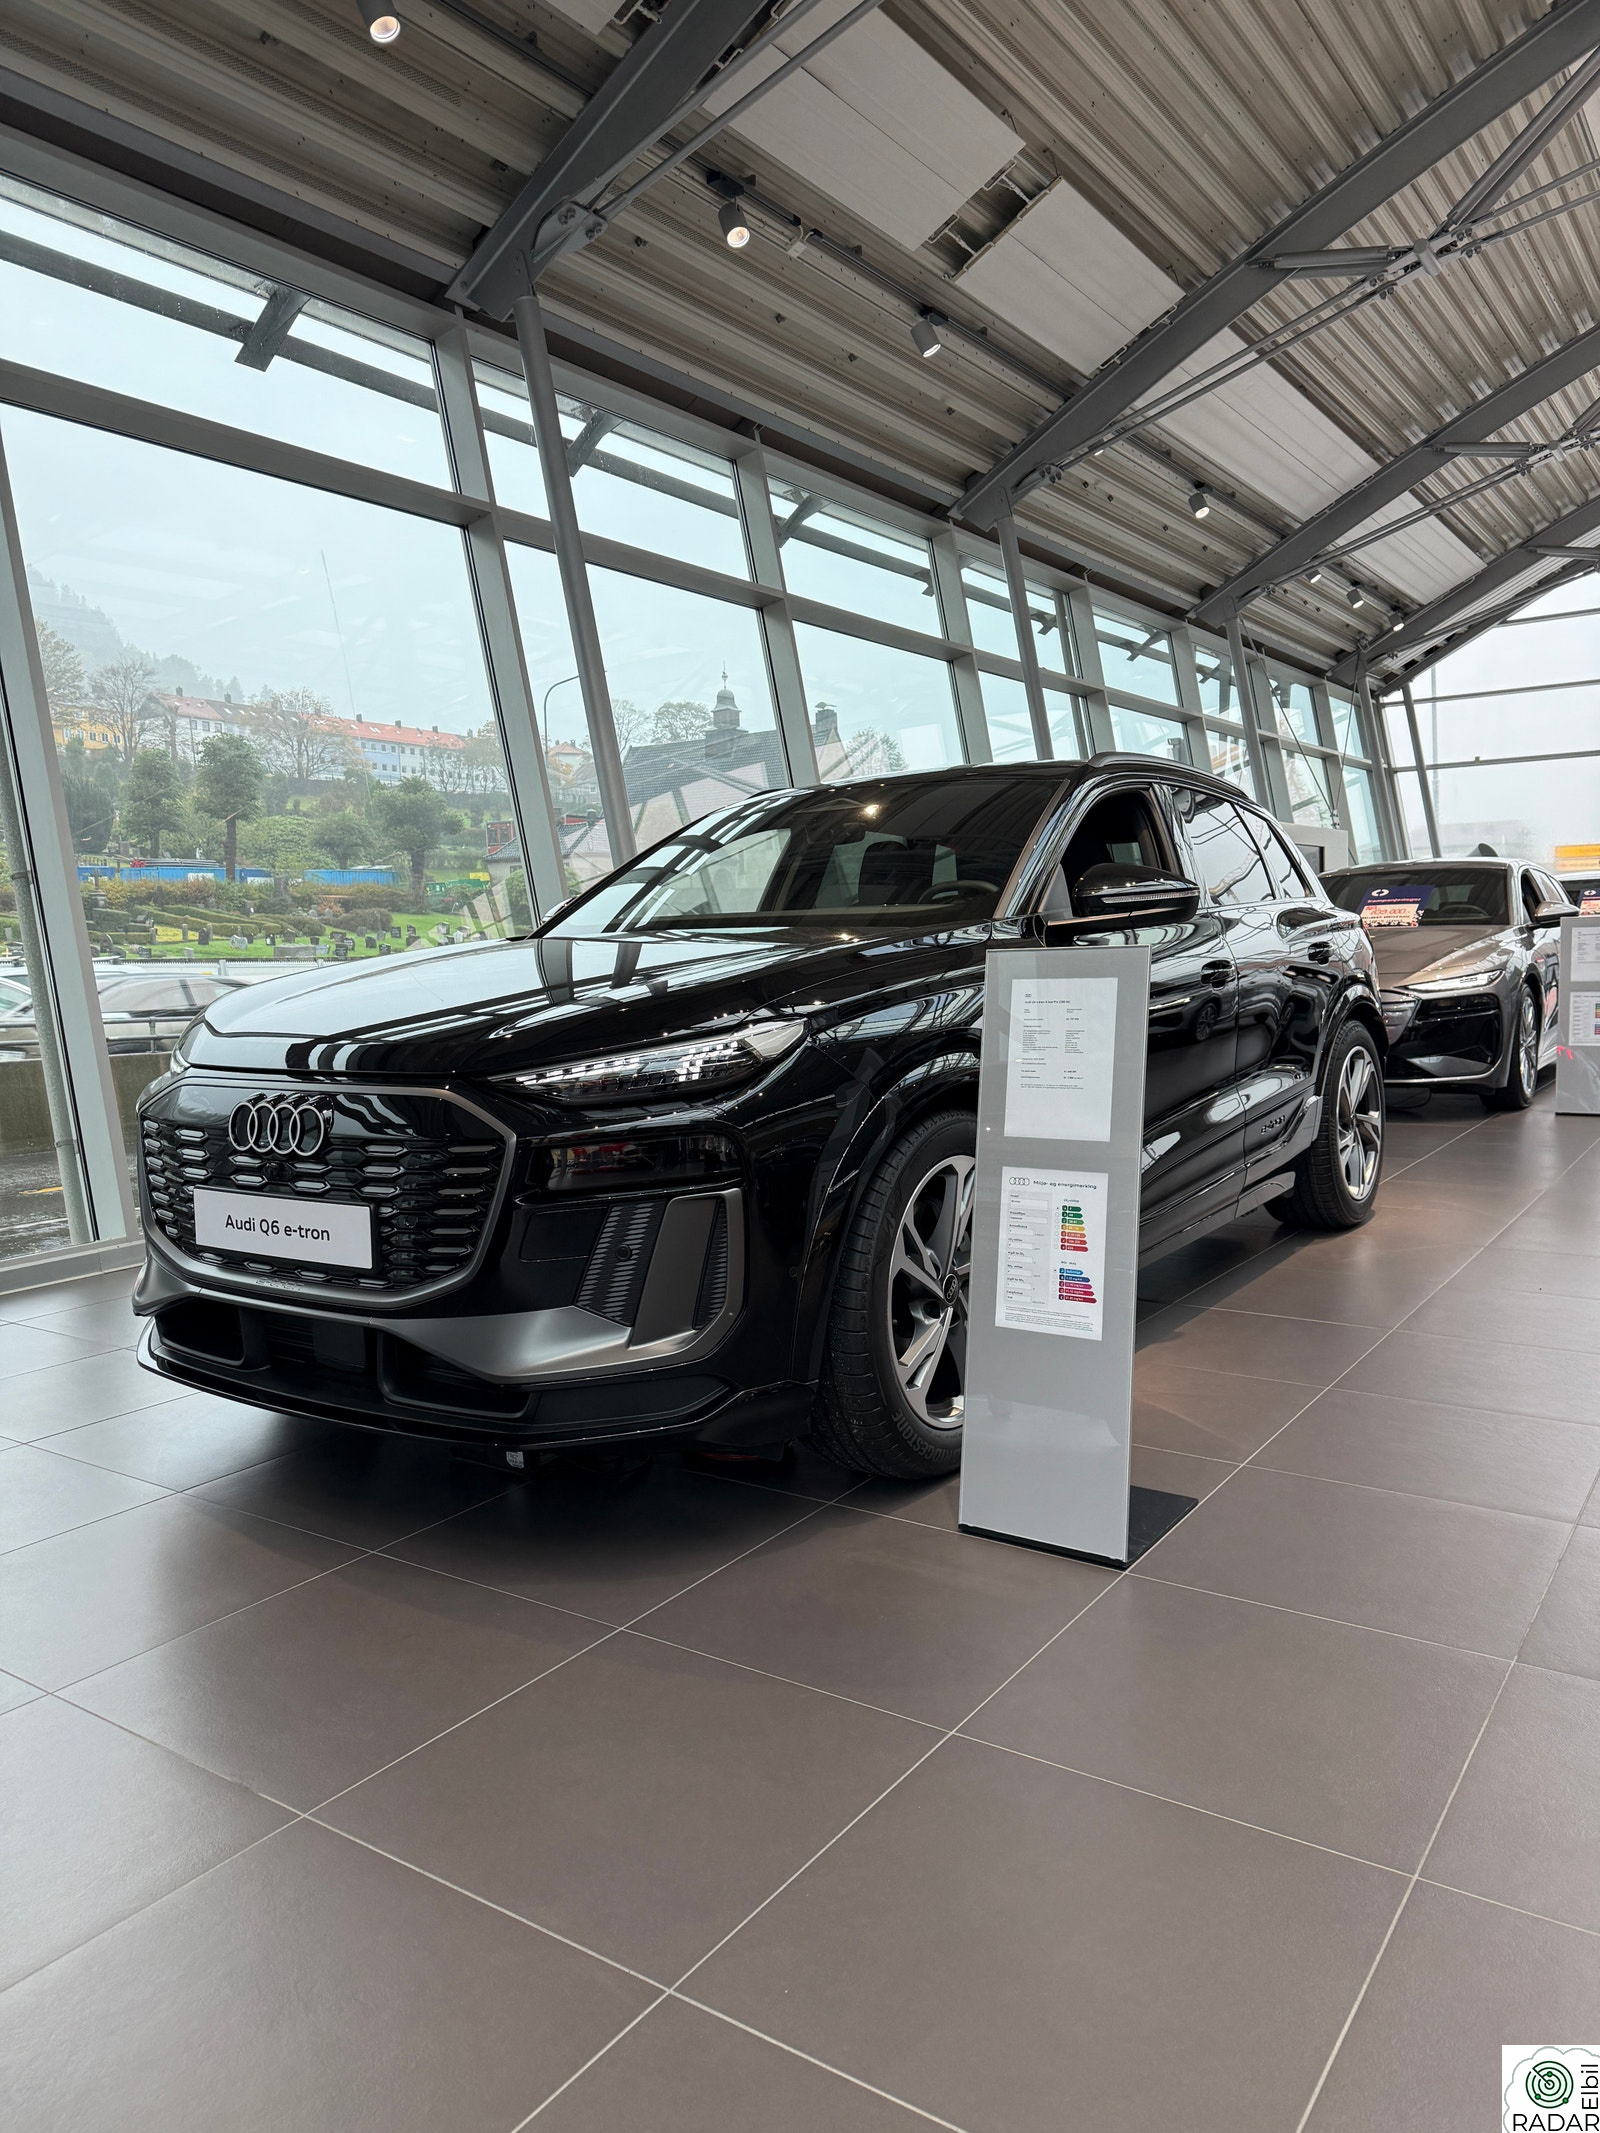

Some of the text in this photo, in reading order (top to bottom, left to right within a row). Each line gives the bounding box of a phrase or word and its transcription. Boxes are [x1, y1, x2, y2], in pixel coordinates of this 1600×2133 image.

[225, 1214, 331, 1241] Audi Q6 e-tron
